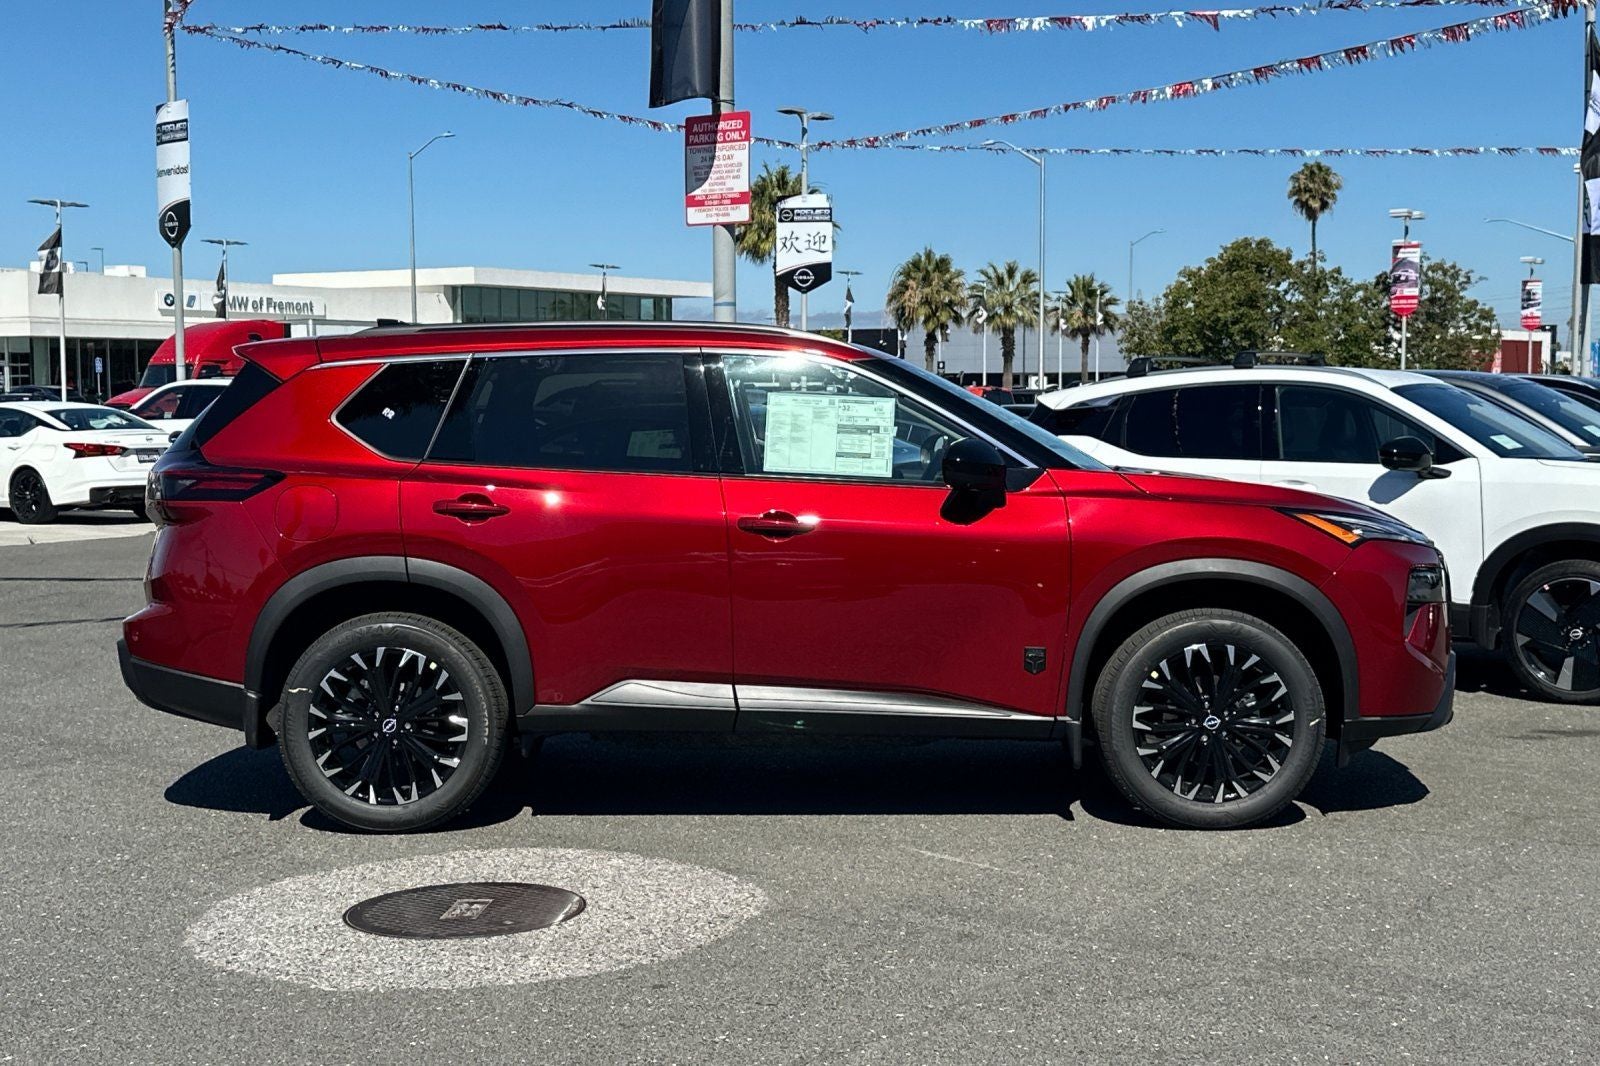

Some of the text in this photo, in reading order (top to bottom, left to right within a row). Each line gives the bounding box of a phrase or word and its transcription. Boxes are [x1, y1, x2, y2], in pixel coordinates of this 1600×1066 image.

[693, 119, 743, 133] AUTHORIZED
[689, 130, 747, 144] PARKING ONLY
[688, 147, 713, 155] TOWING
[722, 153, 734, 161] DAY
[779, 230, 829, 254] 欢迎
[226, 295, 314, 314] MW of Fremont
